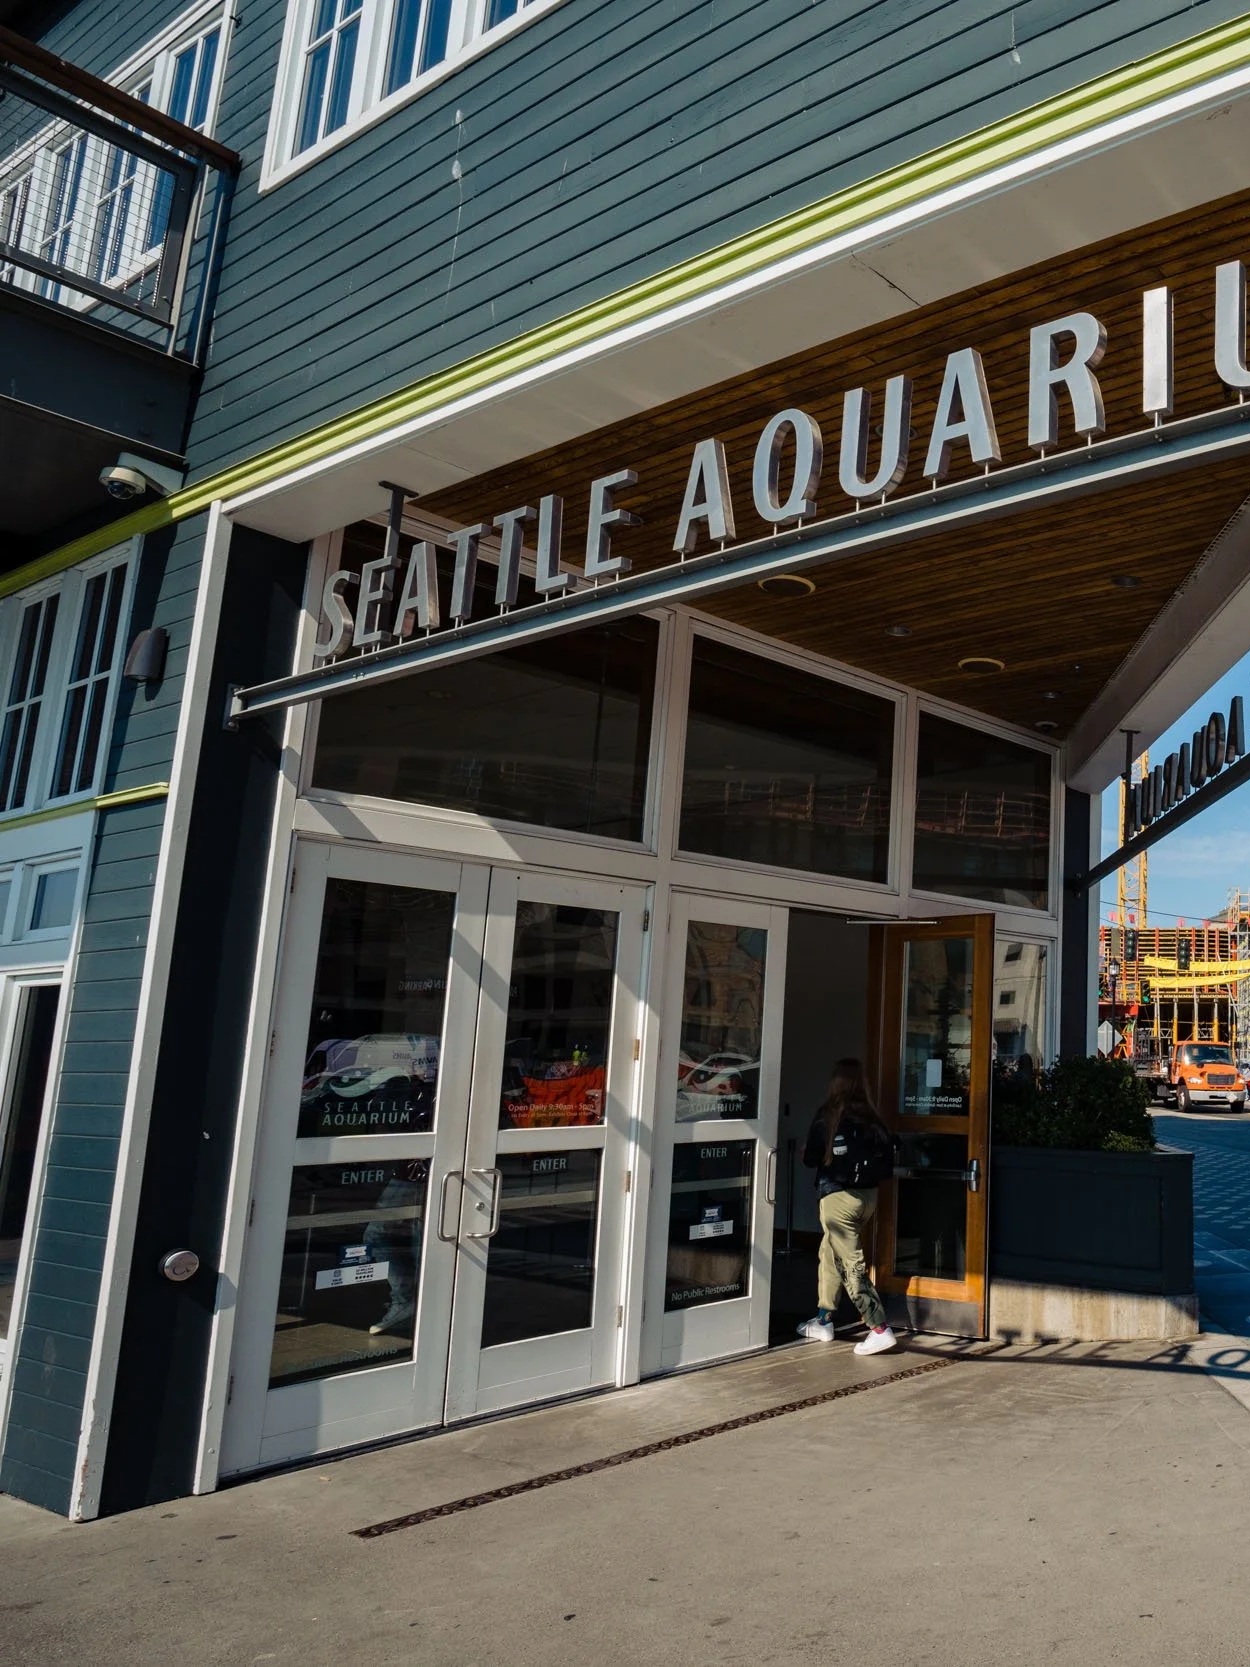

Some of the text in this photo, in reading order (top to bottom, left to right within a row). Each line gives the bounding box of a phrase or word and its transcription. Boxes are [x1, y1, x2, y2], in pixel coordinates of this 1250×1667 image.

[313, 469, 640, 658] SEATTLE
[324, 1101, 413, 1113] SEATTLE
[508, 1104, 528, 1112] Open
[529, 1104, 547, 1112] Daily
[689, 1103, 742, 1113] AQUARIUM
[322, 1112, 410, 1126] AQUARIUM
[701, 1147, 728, 1159] ENTER
[533, 1158, 567, 1172] ENTER
[341, 1169, 385, 1185] ENTER
[671, 1283, 740, 1301] No Public Restrooms
